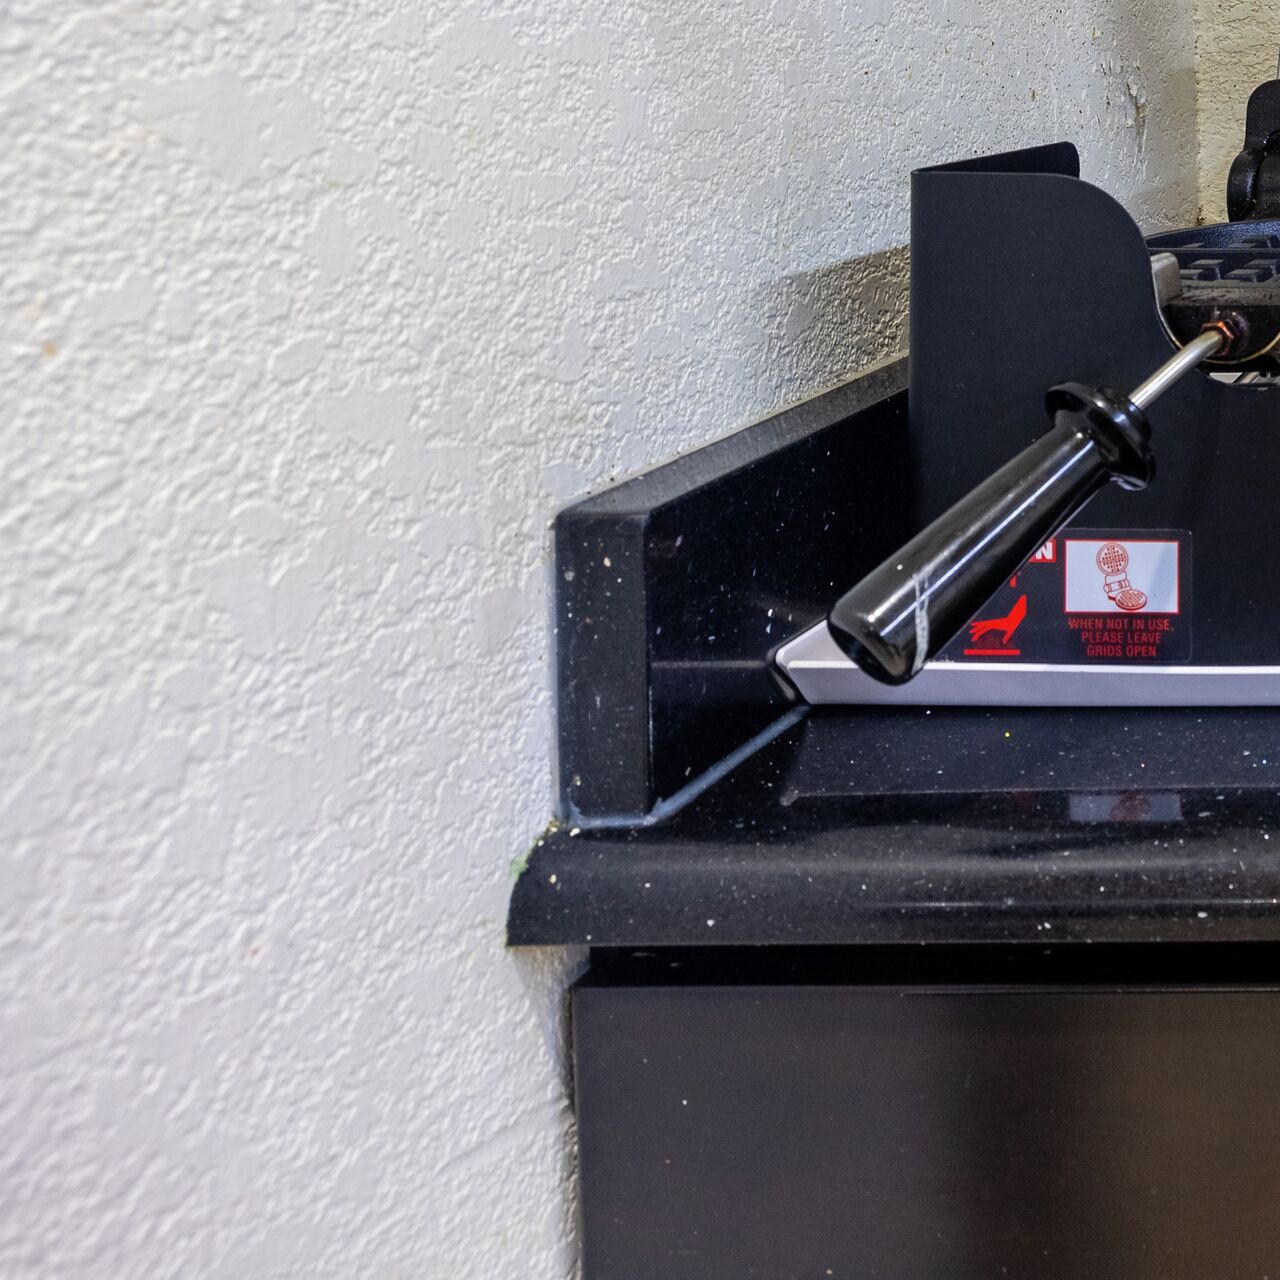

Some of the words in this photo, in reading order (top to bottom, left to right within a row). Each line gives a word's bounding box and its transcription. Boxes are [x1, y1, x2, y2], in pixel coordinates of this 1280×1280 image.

[1068, 619, 1102, 631] WHEN
[1106, 619, 1129, 631] NOT
[1132, 619, 1145, 631] IN
[1081, 631, 1124, 644] PLEASE
[1127, 632, 1162, 644] LEAVE
[1087, 645, 1123, 657] GRIDS
[1126, 645, 1157, 657] OPEN
